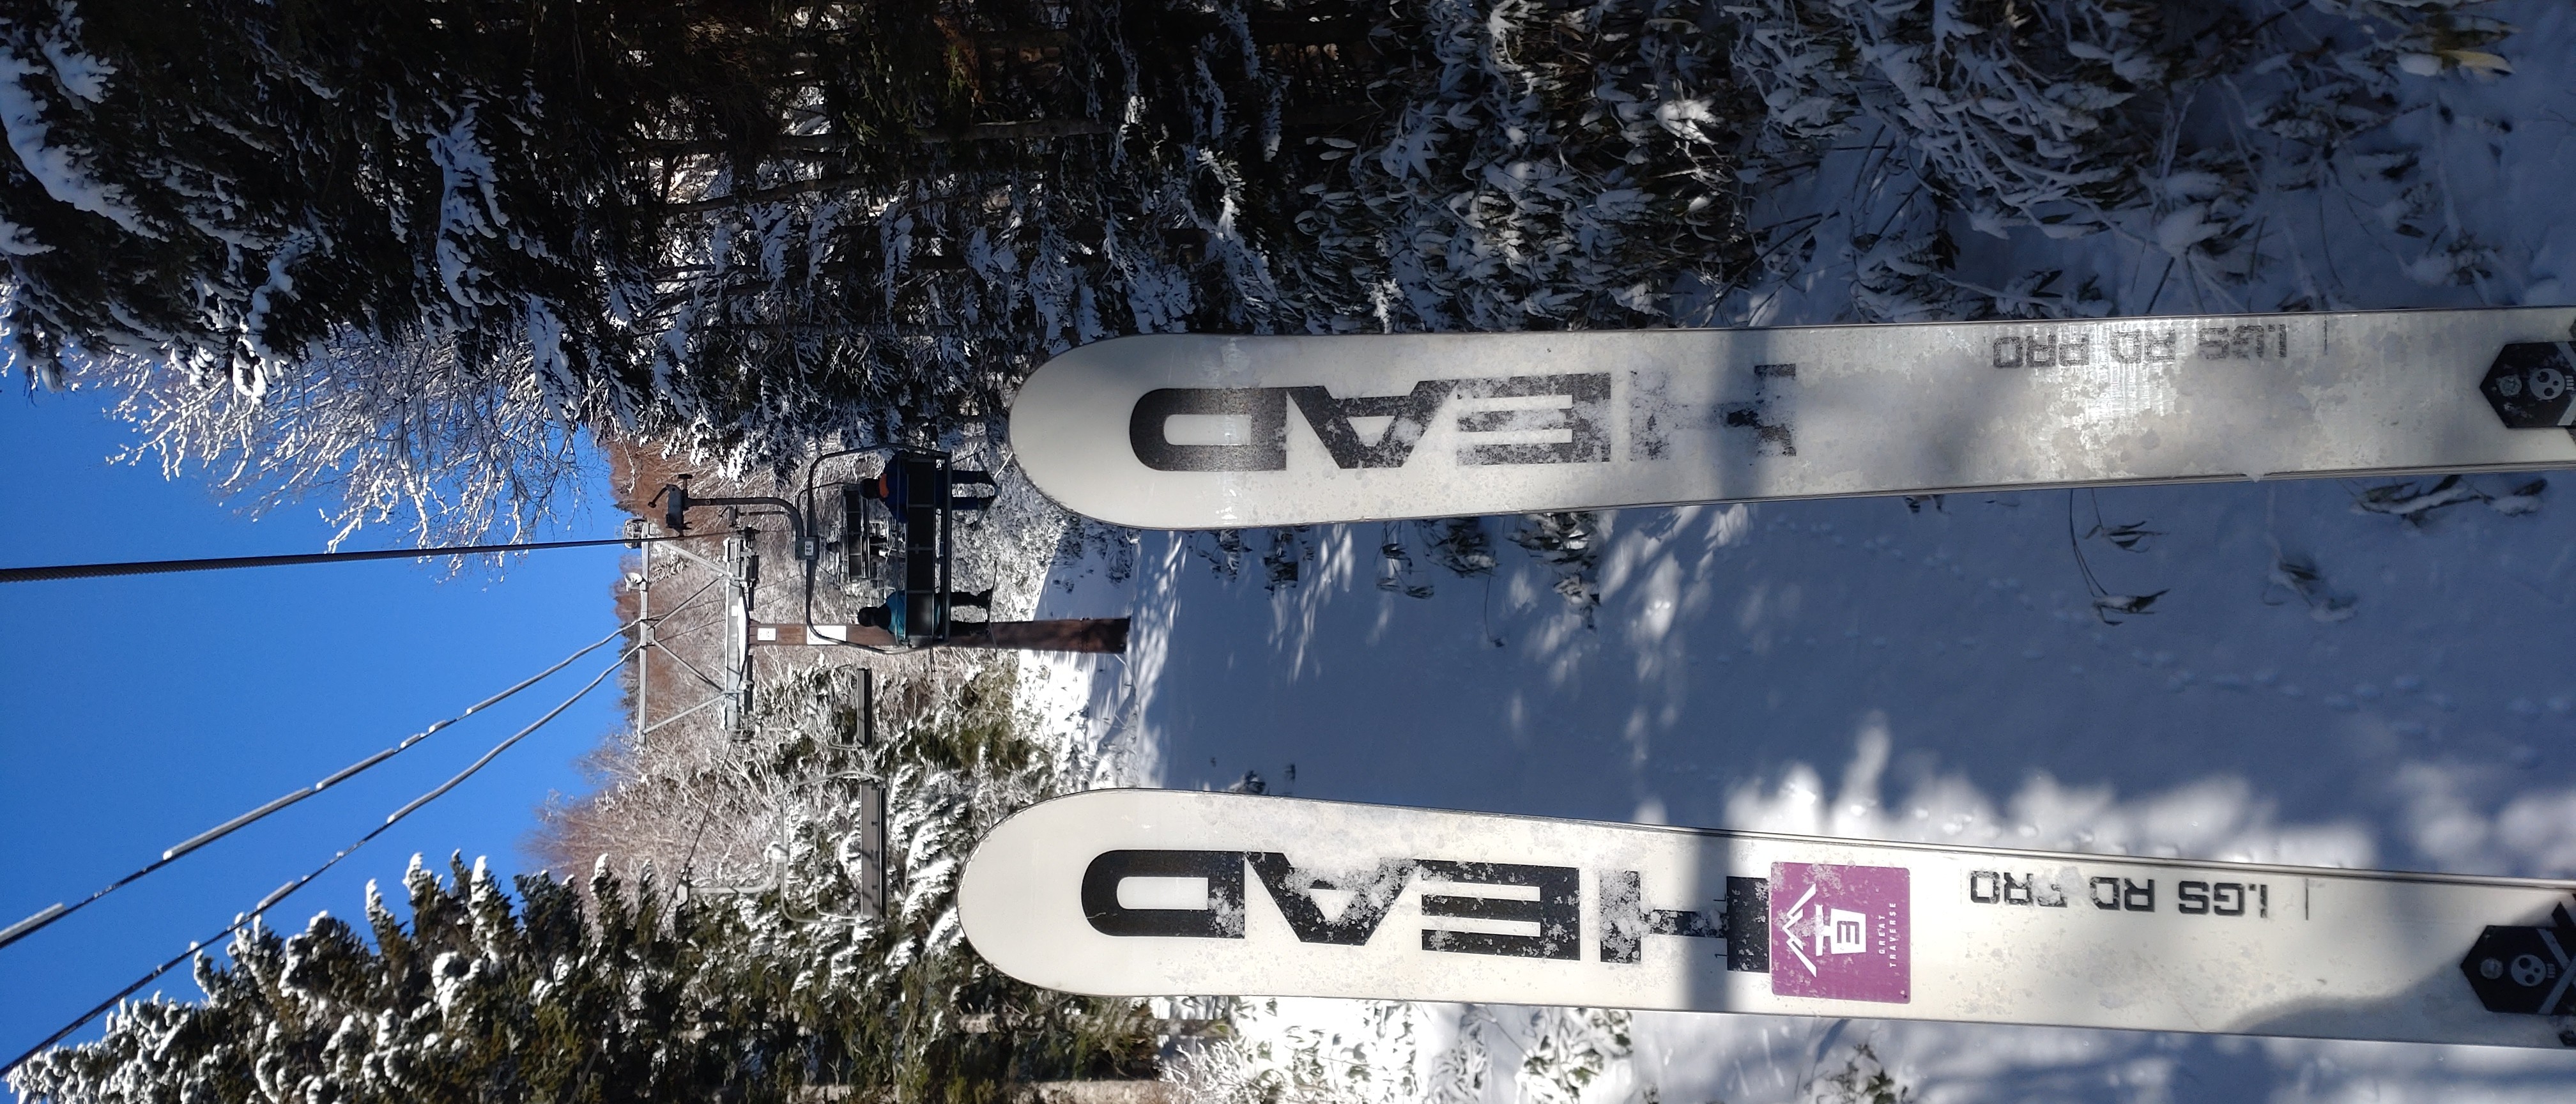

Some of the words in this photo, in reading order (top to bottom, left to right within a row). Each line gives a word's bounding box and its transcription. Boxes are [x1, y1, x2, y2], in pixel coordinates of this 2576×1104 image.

[1993, 334, 2089, 369] PRO
[2110, 328, 2175, 364] RD
[1130, 362, 1797, 472] HEAD
[1081, 848, 1770, 973] HEAD
[2090, 876, 2155, 913] RD
